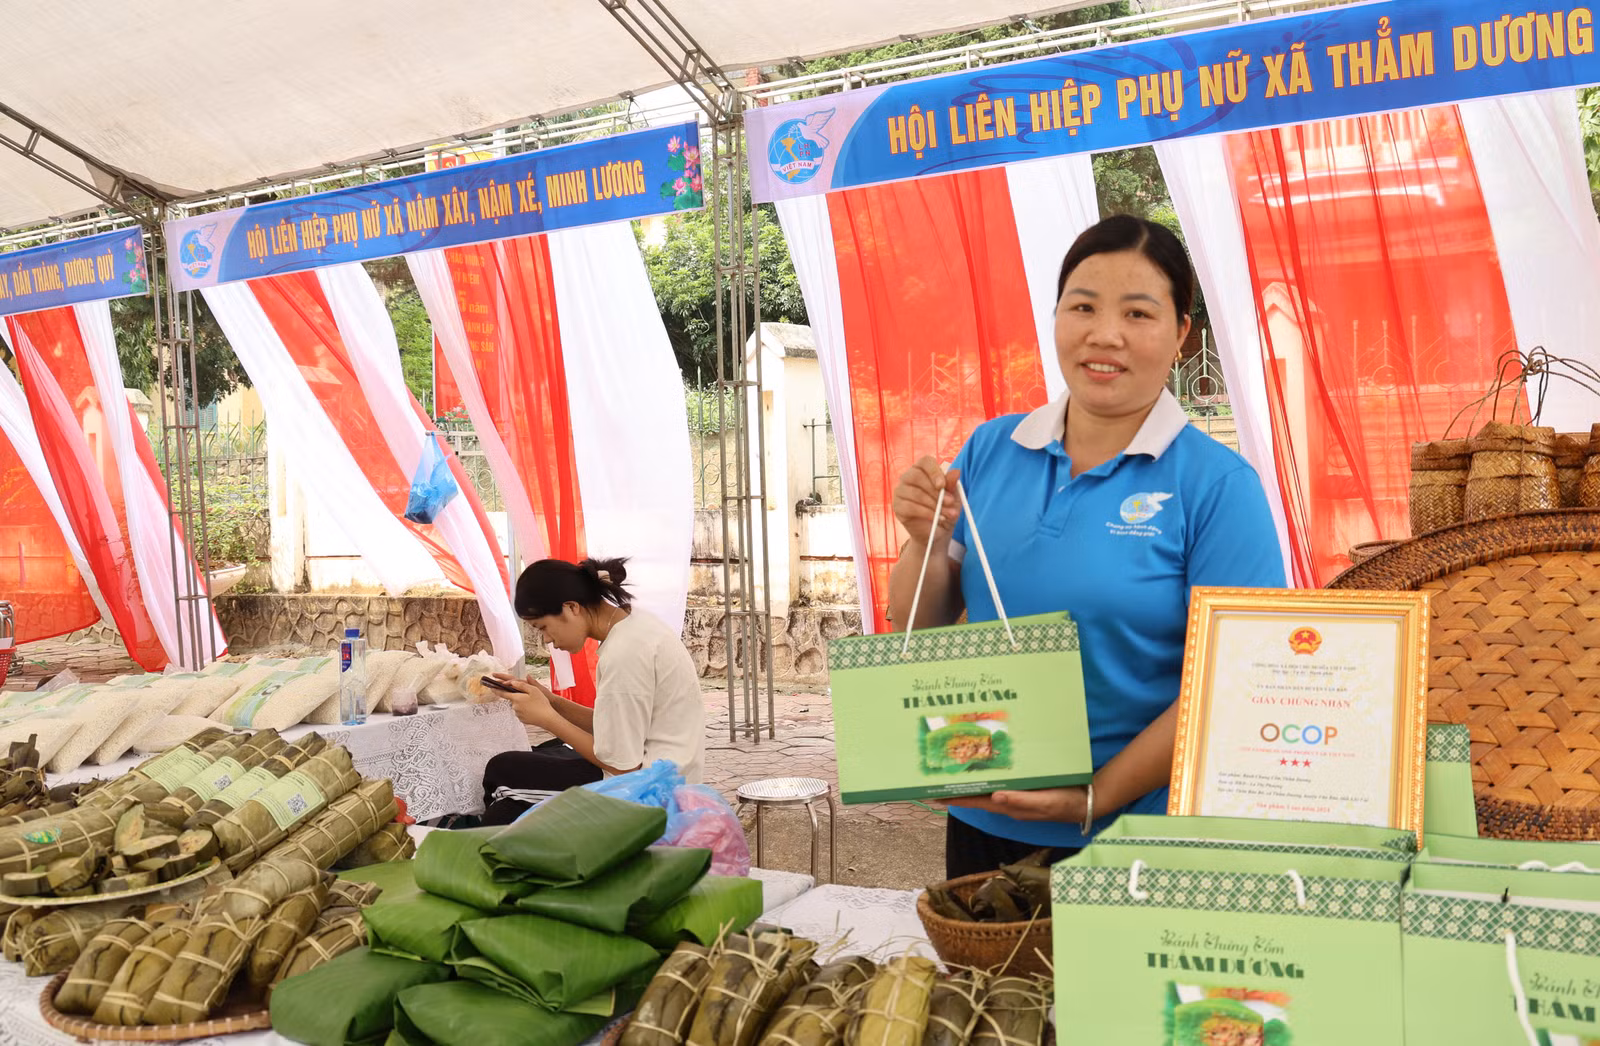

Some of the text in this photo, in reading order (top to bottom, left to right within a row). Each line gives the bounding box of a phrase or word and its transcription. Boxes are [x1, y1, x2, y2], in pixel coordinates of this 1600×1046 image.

[888, 8, 1594, 160] HỘI LIÊN HIỆP PHỤ NỮ XÃ THẲM DƯƠNG
[246, 160, 646, 264] HỘI LIÊN HIỆP PHỤ NỮ XÃ NẬM XÂY, NẬM XÉ, MINH LƯƠNG
[64, 257, 96, 288] DƯƠNG
[1260, 723, 1338, 745] OCOP
